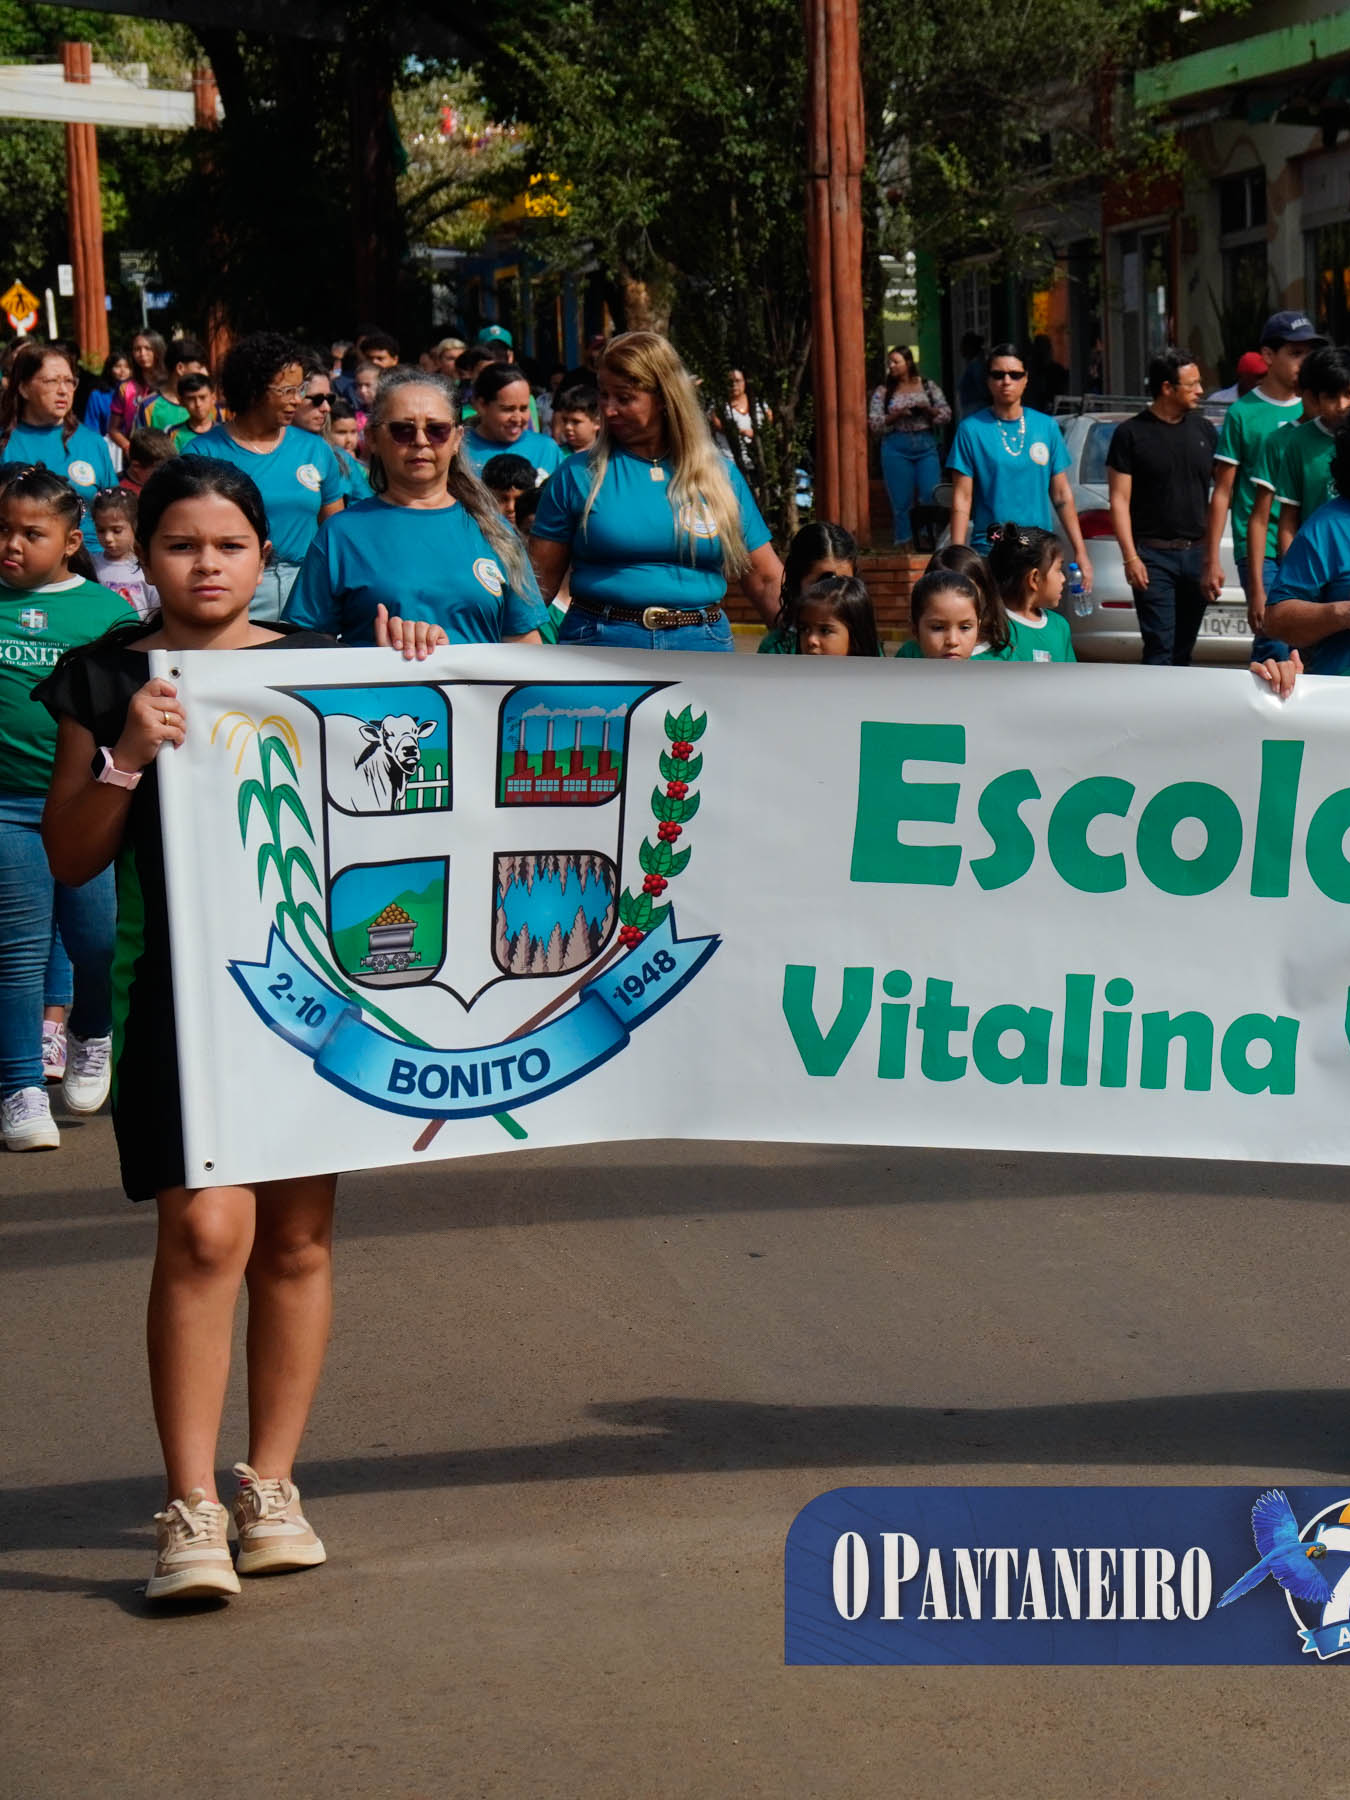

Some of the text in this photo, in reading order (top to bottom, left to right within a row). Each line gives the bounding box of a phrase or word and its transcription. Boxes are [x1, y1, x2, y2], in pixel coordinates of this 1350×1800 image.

[0, 645, 64, 663] ONIT
[266, 971, 328, 1029] 2-10
[612, 949, 677, 1007] 1948
[782, 964, 1300, 1096] Vitalina
[386, 1046, 552, 1100] BONITO
